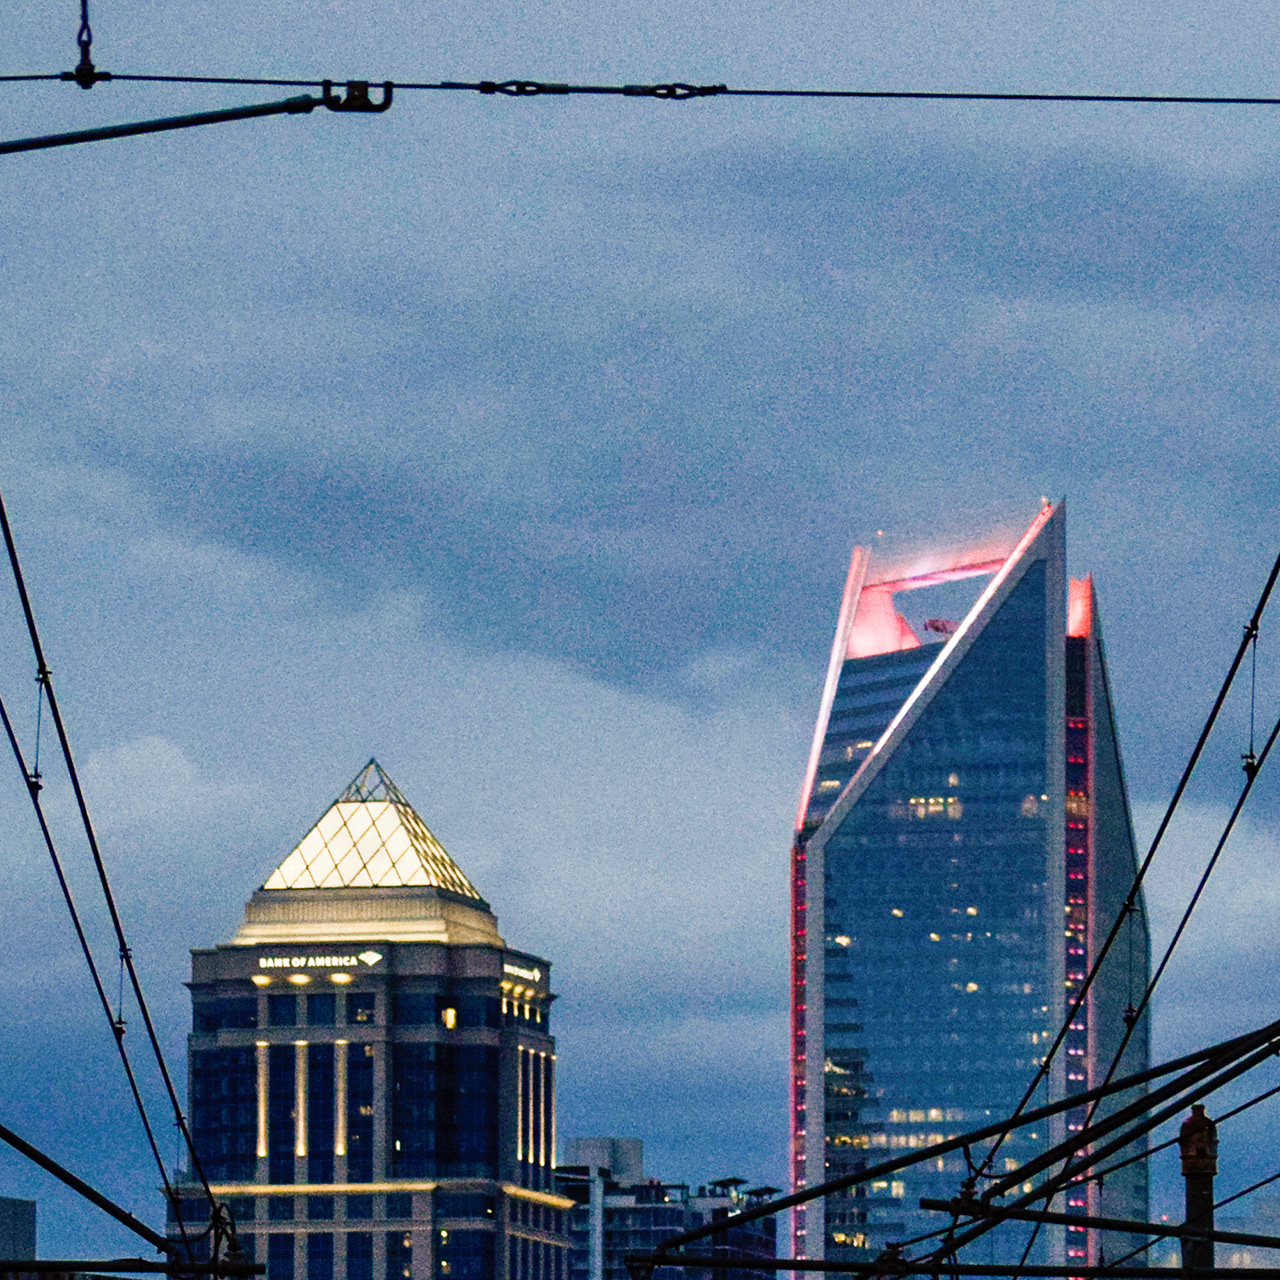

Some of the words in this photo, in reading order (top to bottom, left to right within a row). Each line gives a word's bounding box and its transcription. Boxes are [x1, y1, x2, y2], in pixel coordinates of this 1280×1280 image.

[259, 957, 290, 968] BANK
[291, 957, 307, 968] OF
[307, 955, 358, 967] AMERICA
